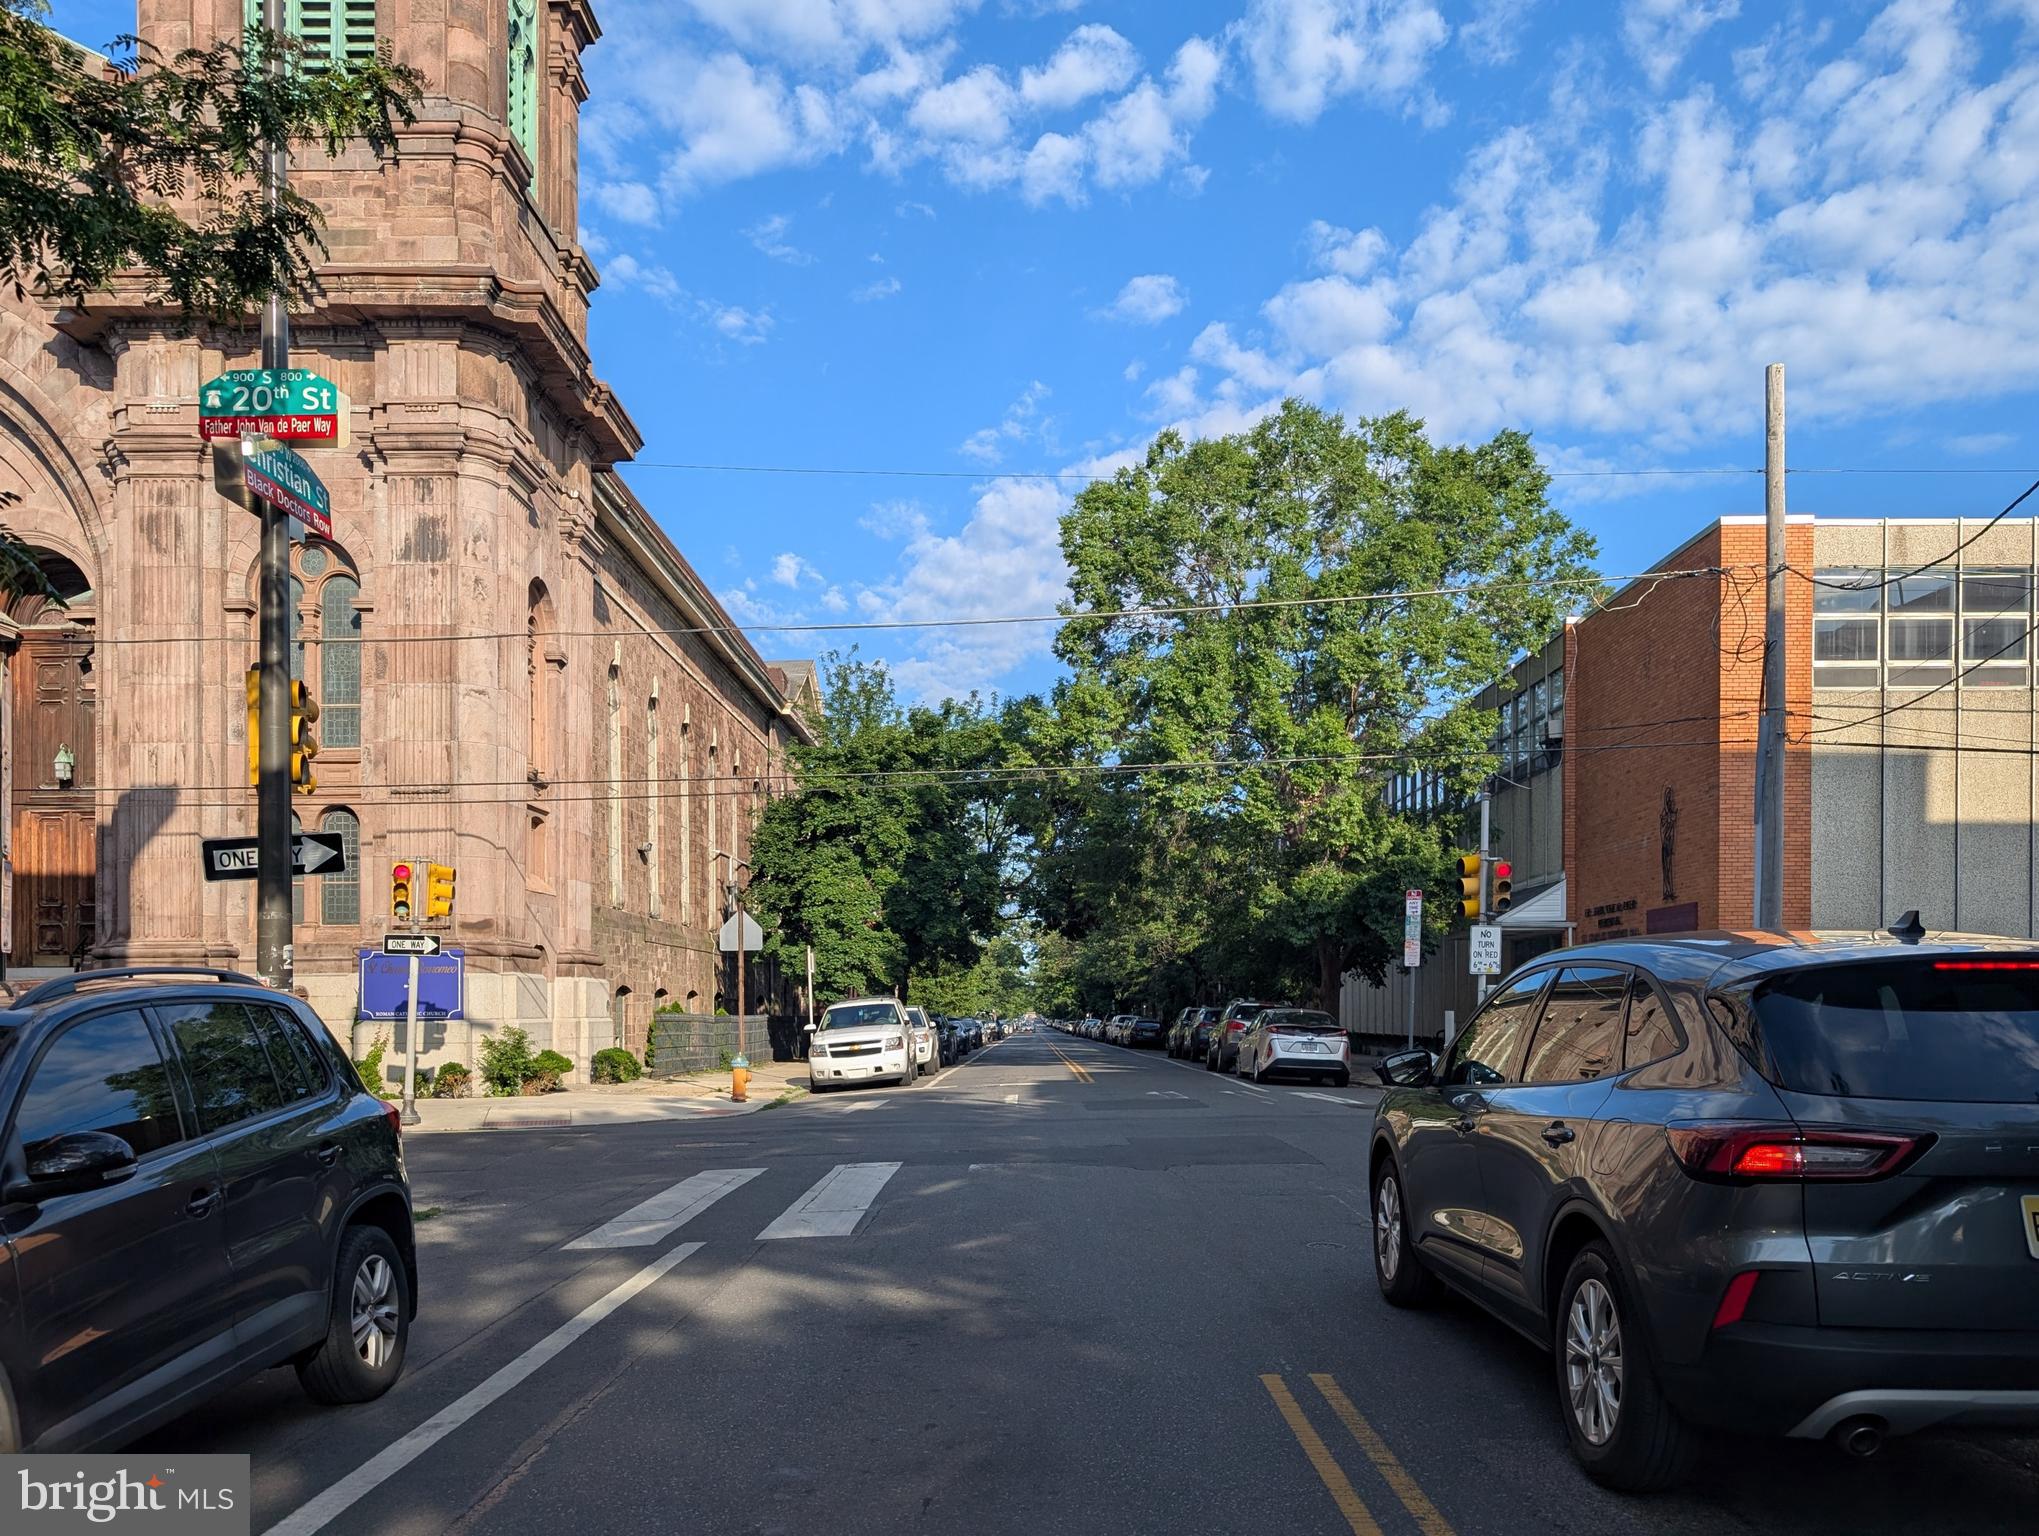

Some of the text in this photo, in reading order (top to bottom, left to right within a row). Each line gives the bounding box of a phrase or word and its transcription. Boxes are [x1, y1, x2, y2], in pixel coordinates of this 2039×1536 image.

[233, 372, 302, 384] 900 S 800
[232, 384, 331, 411] 20th St
[204, 417, 331, 435] Father John Van de Paer Way
[247, 470, 331, 535] Black Doctors Row
[316, 486, 329, 513] St
[219, 851, 258, 868] ONE
[1480, 930, 1492, 939] NO
[391, 939, 425, 949] ONE WAY
[1477, 940, 1495, 949] TURN
[1472, 950, 1498, 959] ON RED
[1832, 1272, 1932, 1282] ACTIVE
